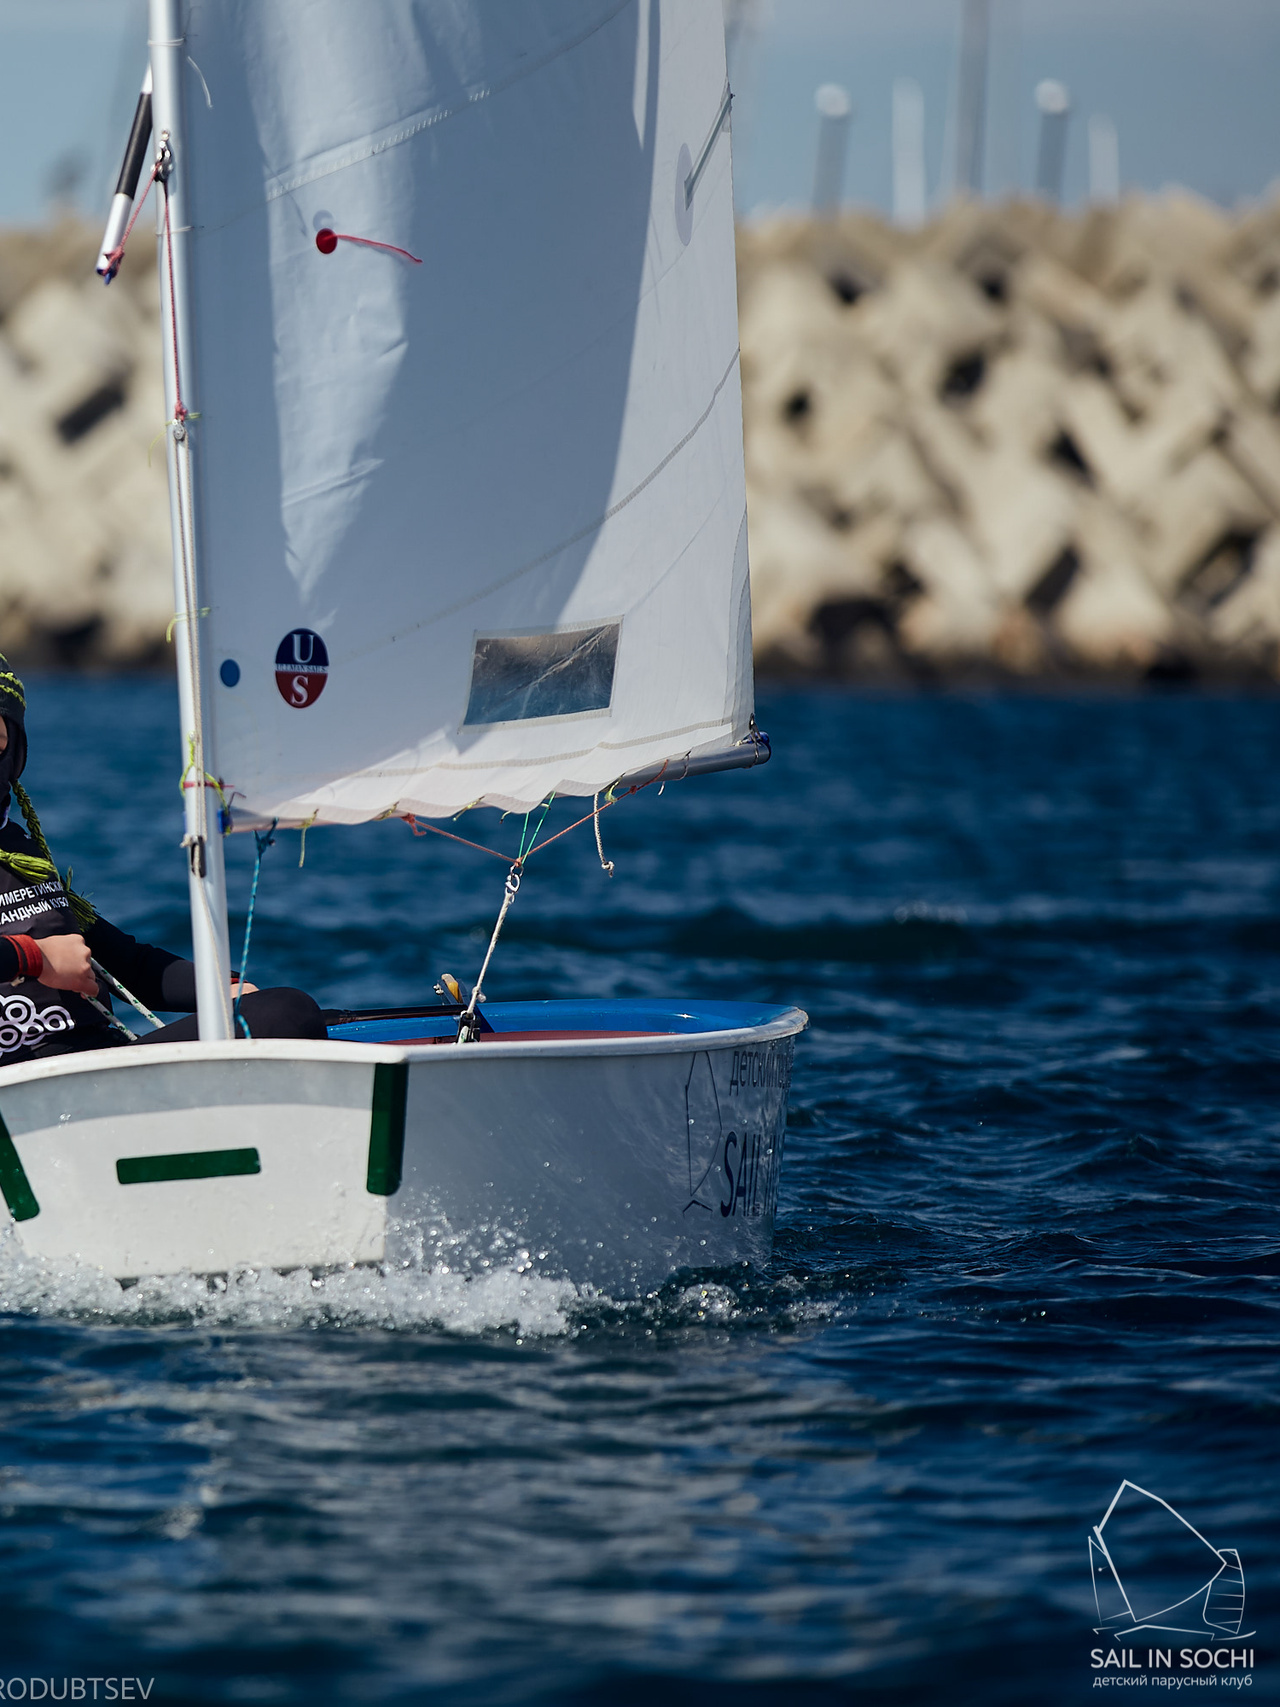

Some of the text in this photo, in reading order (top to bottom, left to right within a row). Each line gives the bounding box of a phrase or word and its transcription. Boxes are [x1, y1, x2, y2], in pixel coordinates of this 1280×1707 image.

[292, 633, 314, 664] U
[291, 675, 309, 704] S
[49, 896, 69, 908] КУБО
